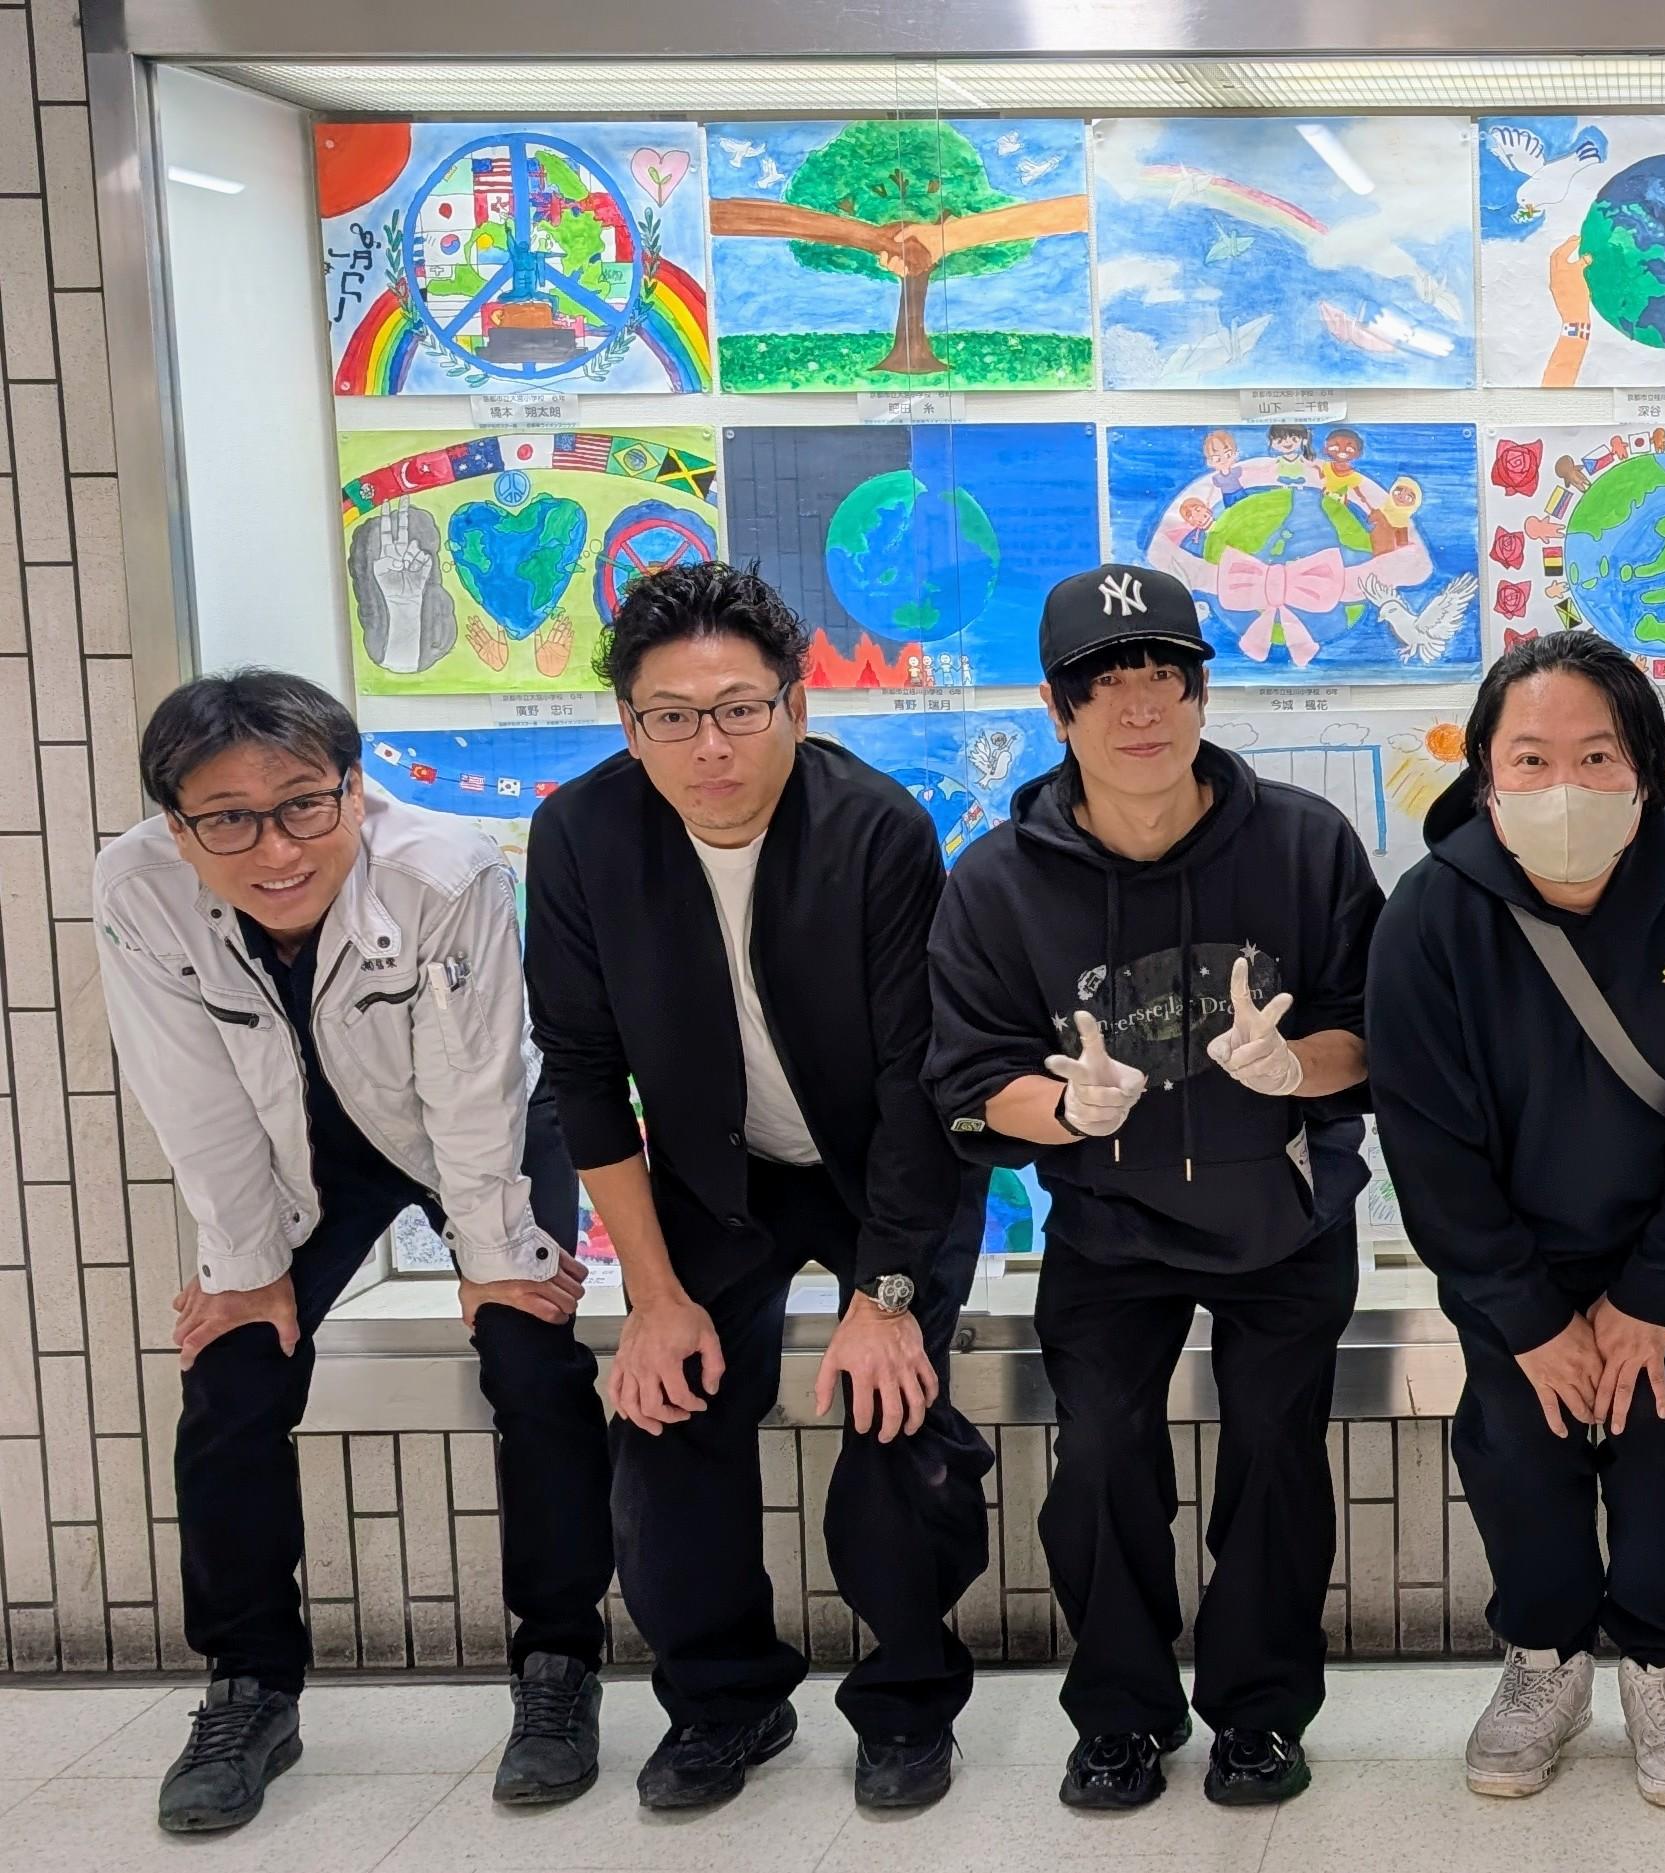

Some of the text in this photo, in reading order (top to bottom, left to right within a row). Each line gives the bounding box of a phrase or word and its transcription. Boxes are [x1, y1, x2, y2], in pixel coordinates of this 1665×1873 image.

[490, 406, 513, 418] 橋本
[923, 402, 935, 414] 糸
[1258, 402, 1282, 414] 山下
[1638, 405, 1661, 417] 深谷
[1098, 572, 1147, 616] NY
